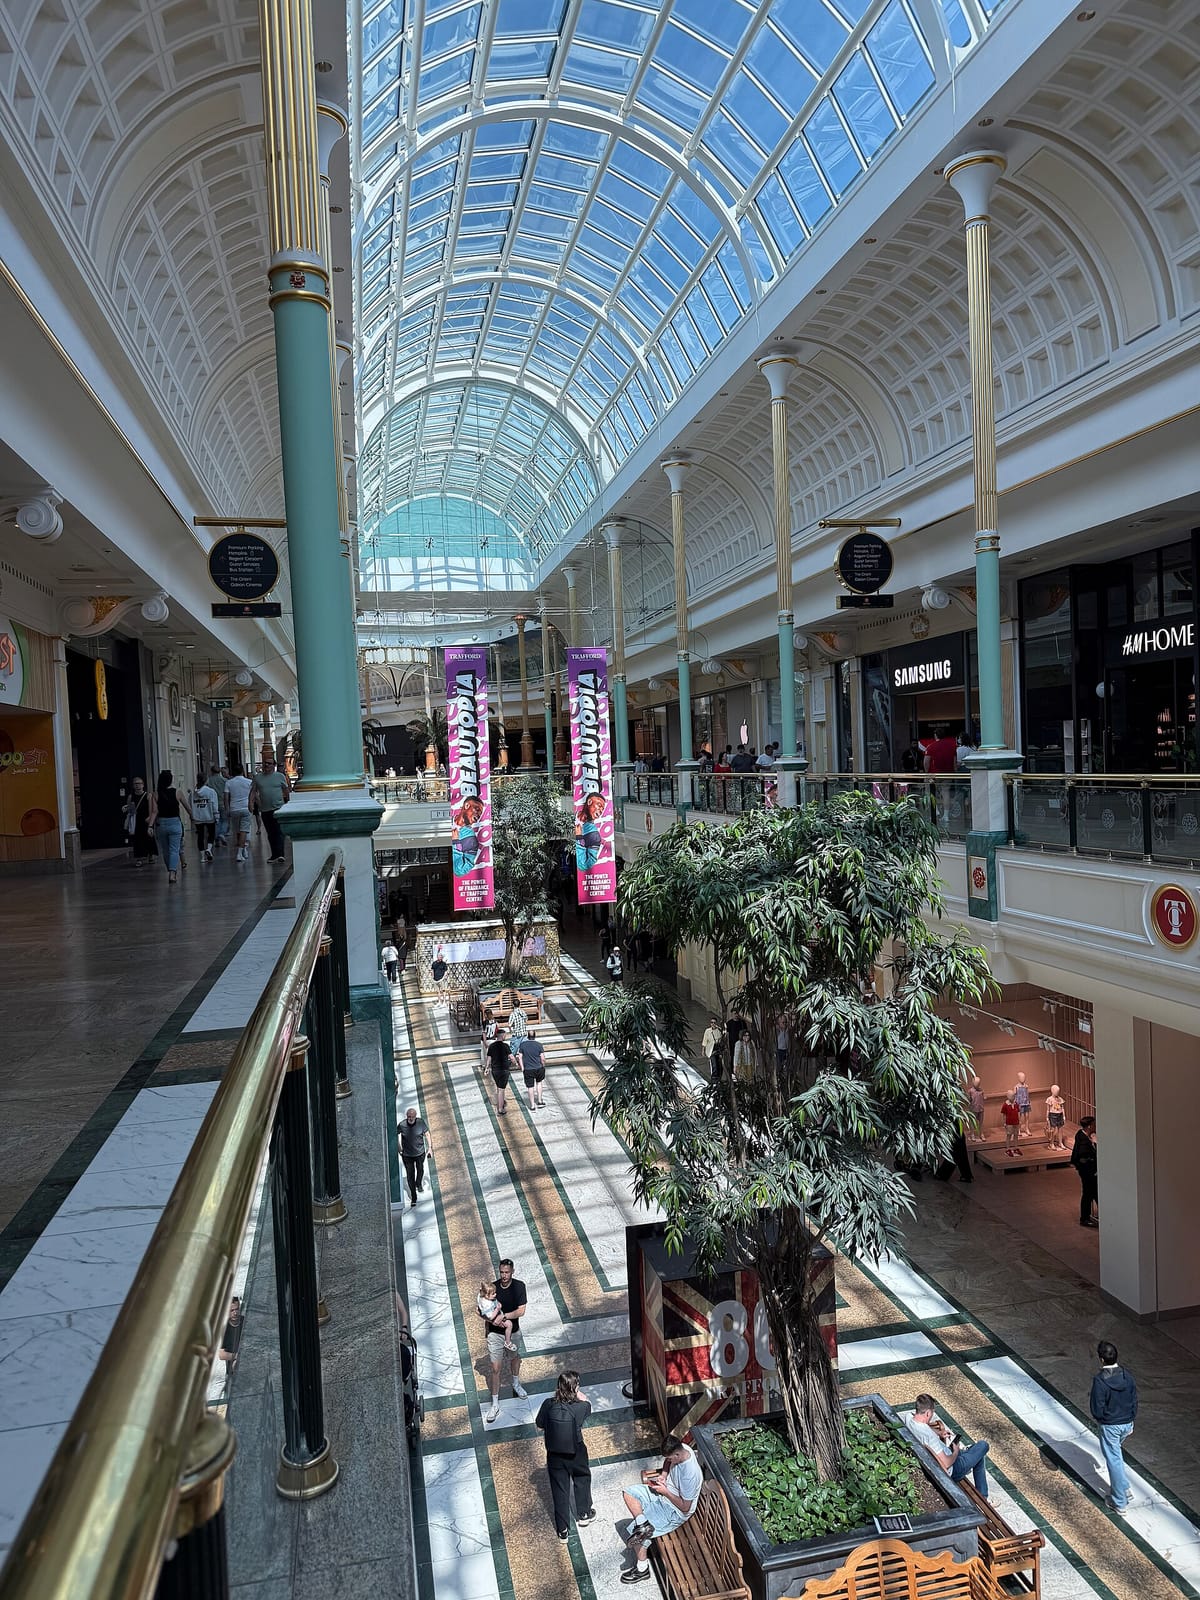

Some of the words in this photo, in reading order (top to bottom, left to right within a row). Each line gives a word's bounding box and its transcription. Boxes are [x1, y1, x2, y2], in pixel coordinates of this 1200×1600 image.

[894, 660, 951, 687] SAMSUNG
[1144, 624, 1195, 652] HOME
[456, 672, 478, 796] BEAUTOPIA
[578, 672, 600, 793] BEAUTOPIA
